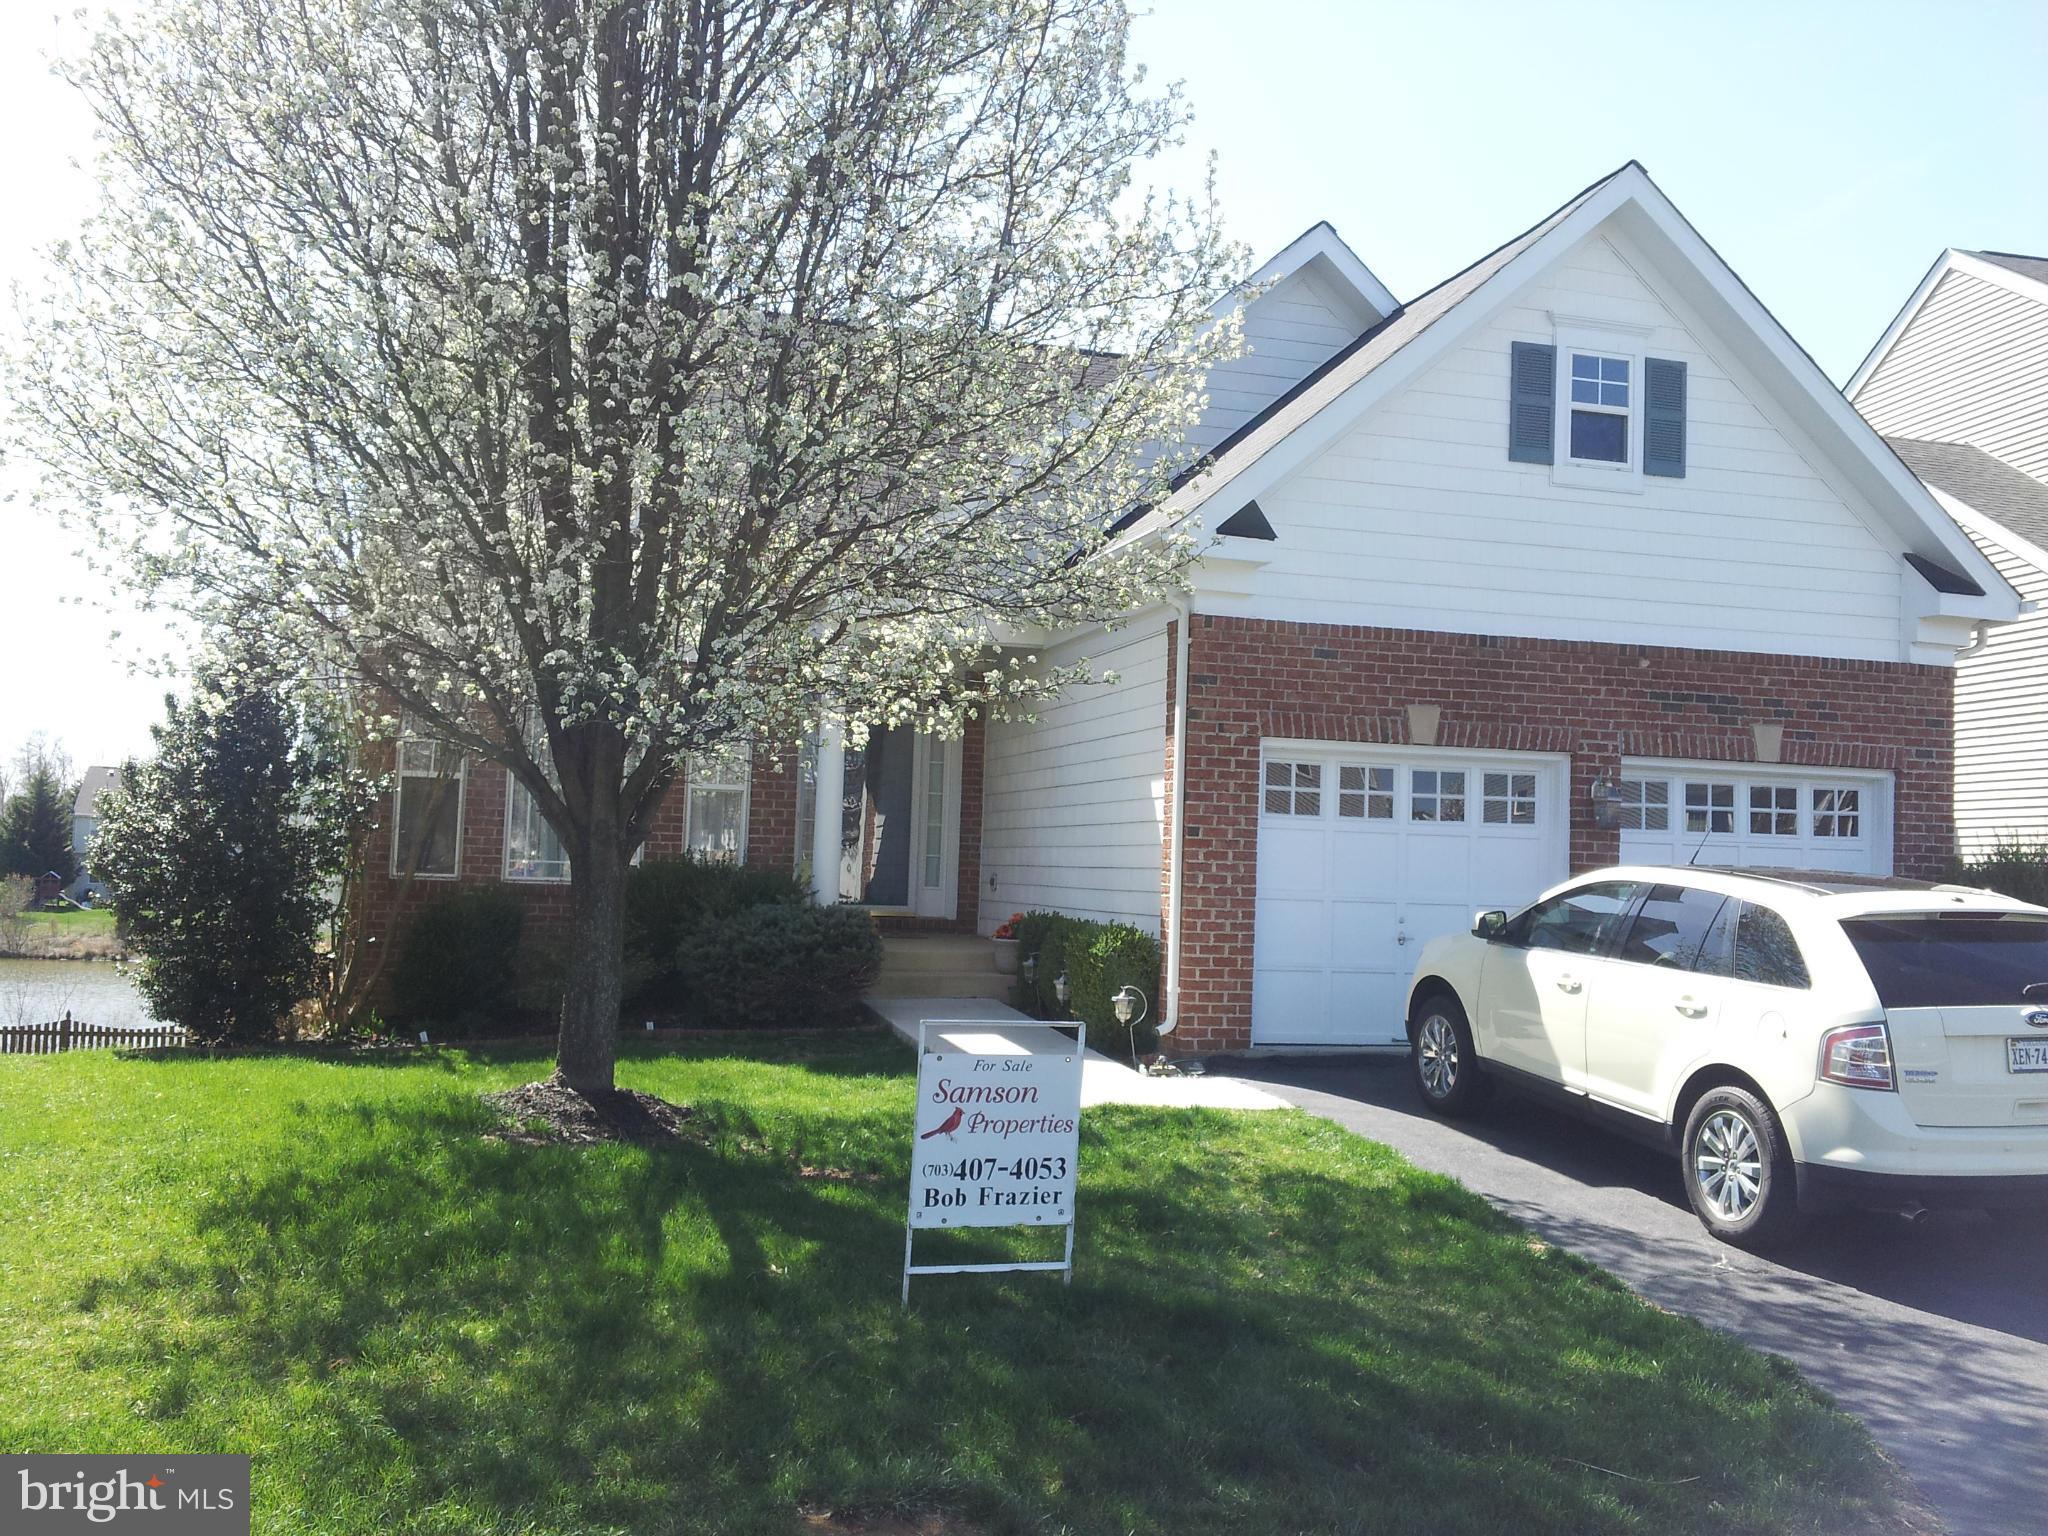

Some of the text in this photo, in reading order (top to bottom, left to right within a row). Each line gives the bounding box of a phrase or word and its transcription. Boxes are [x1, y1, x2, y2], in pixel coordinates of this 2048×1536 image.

[973, 1060, 1033, 1072] For Sale
[932, 1078, 1039, 1104] Samson
[967, 1110, 1074, 1140] Properties
[924, 1185, 1063, 1208] Bob Frazier
